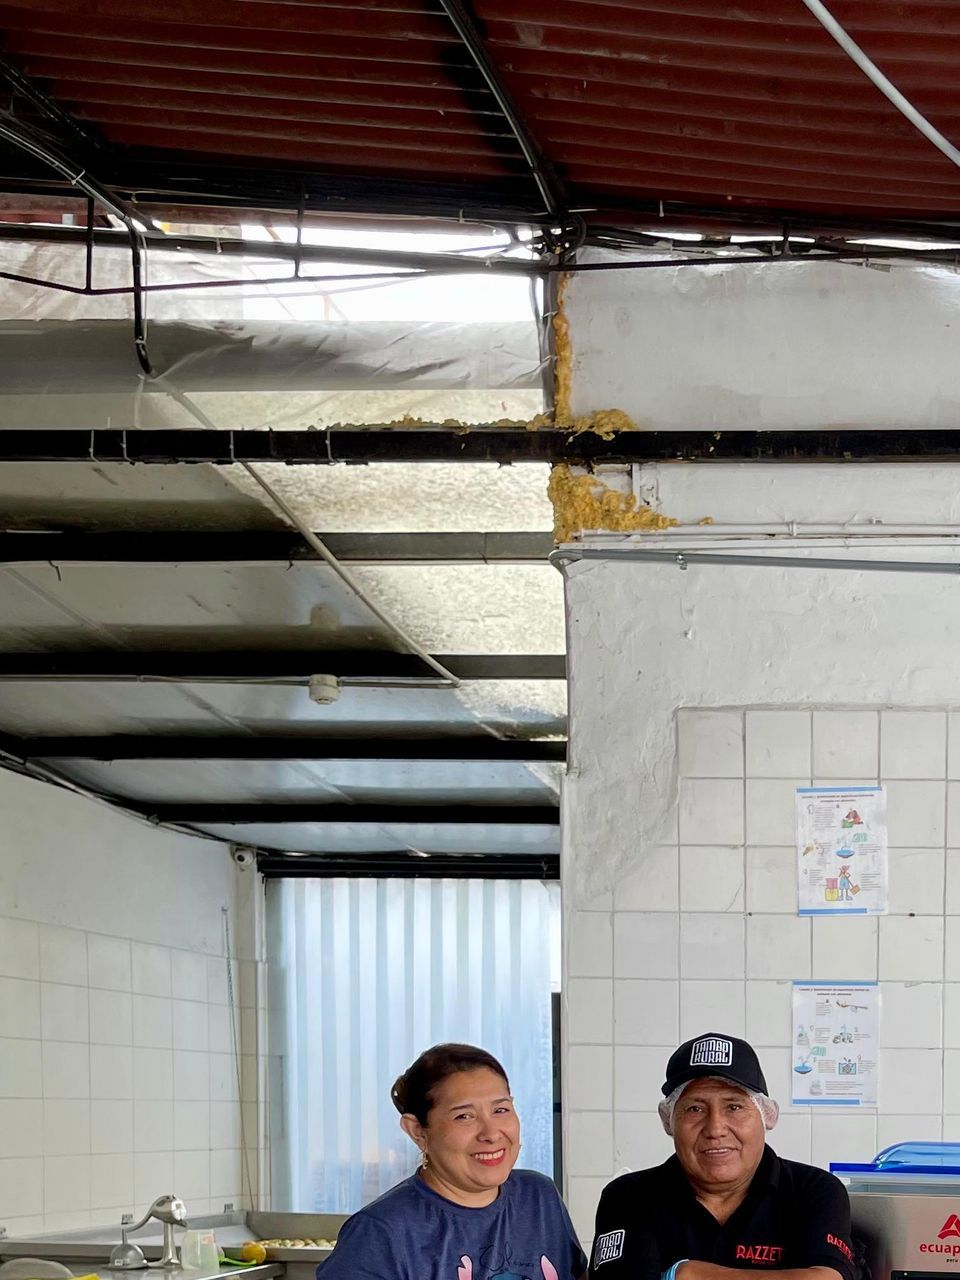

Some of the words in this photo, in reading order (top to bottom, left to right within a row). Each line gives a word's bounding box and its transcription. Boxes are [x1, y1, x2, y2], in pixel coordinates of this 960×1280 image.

[696, 1040, 728, 1053] TAMBO
[694, 1051, 728, 1063] RURAL
[736, 1245, 783, 1261] RAZZET
